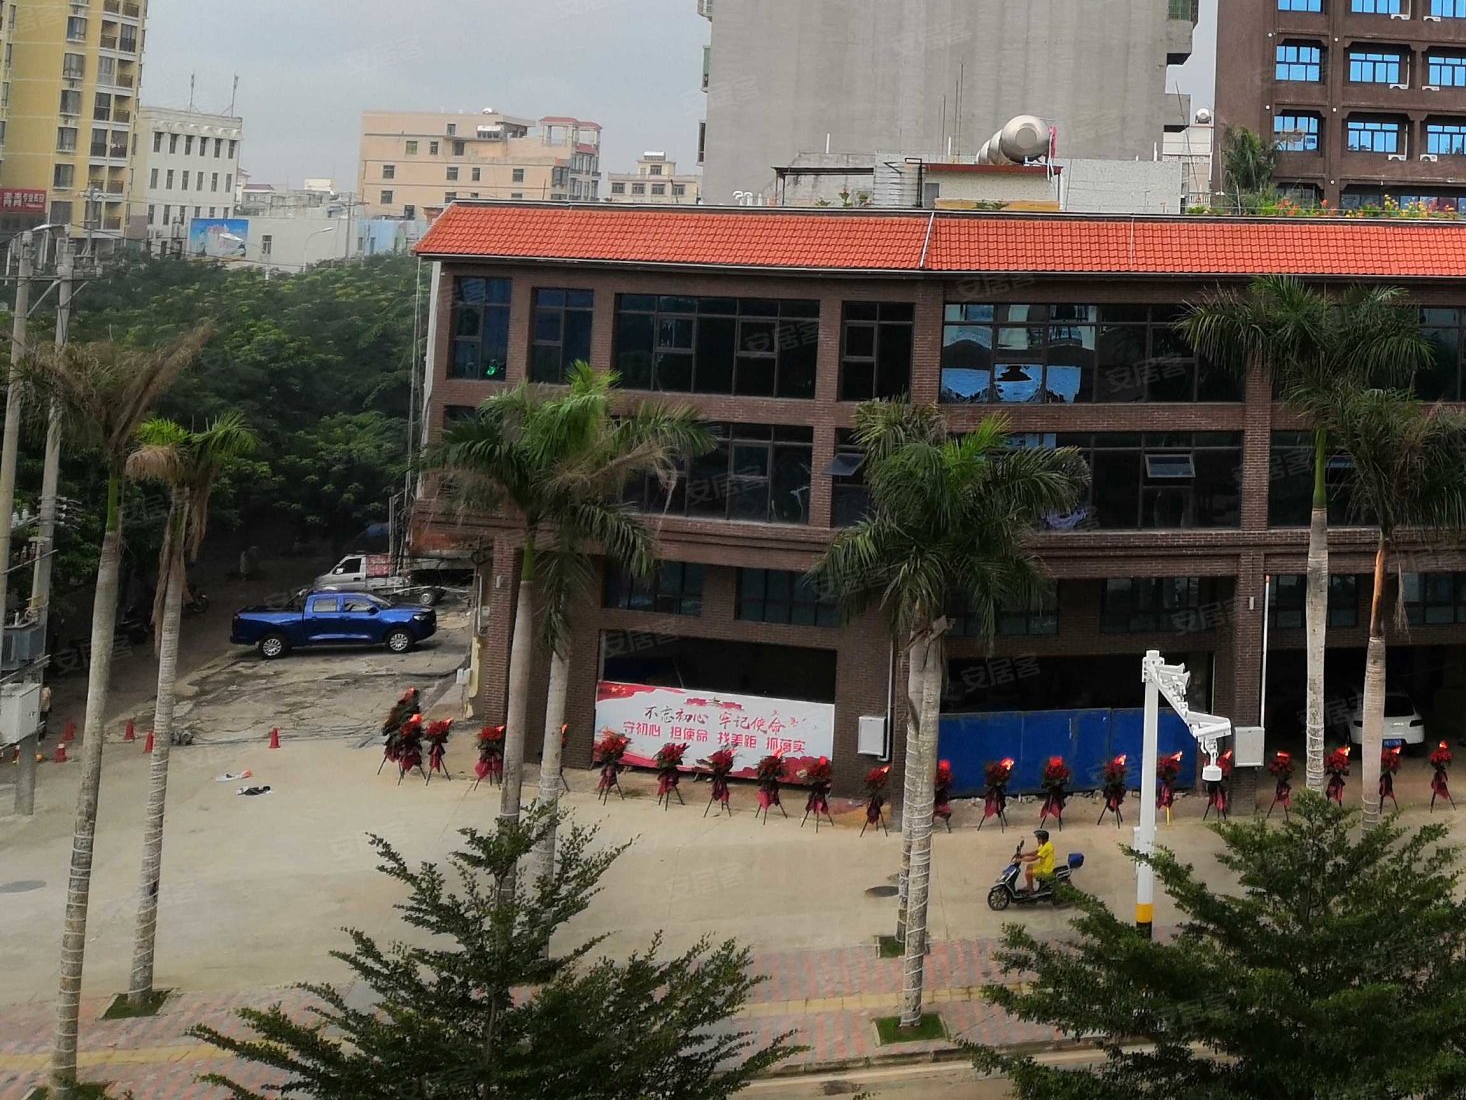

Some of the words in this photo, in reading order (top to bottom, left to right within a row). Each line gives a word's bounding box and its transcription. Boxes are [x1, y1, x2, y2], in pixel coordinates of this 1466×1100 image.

[644, 705, 709, 724] 不忘初心
[719, 710, 785, 736] 牢记使命
[623, 721, 661, 737] 守初心
[670, 726, 708, 742] 担使命
[717, 731, 757, 748] 找差距
[766, 737, 806, 754] 抓落实
